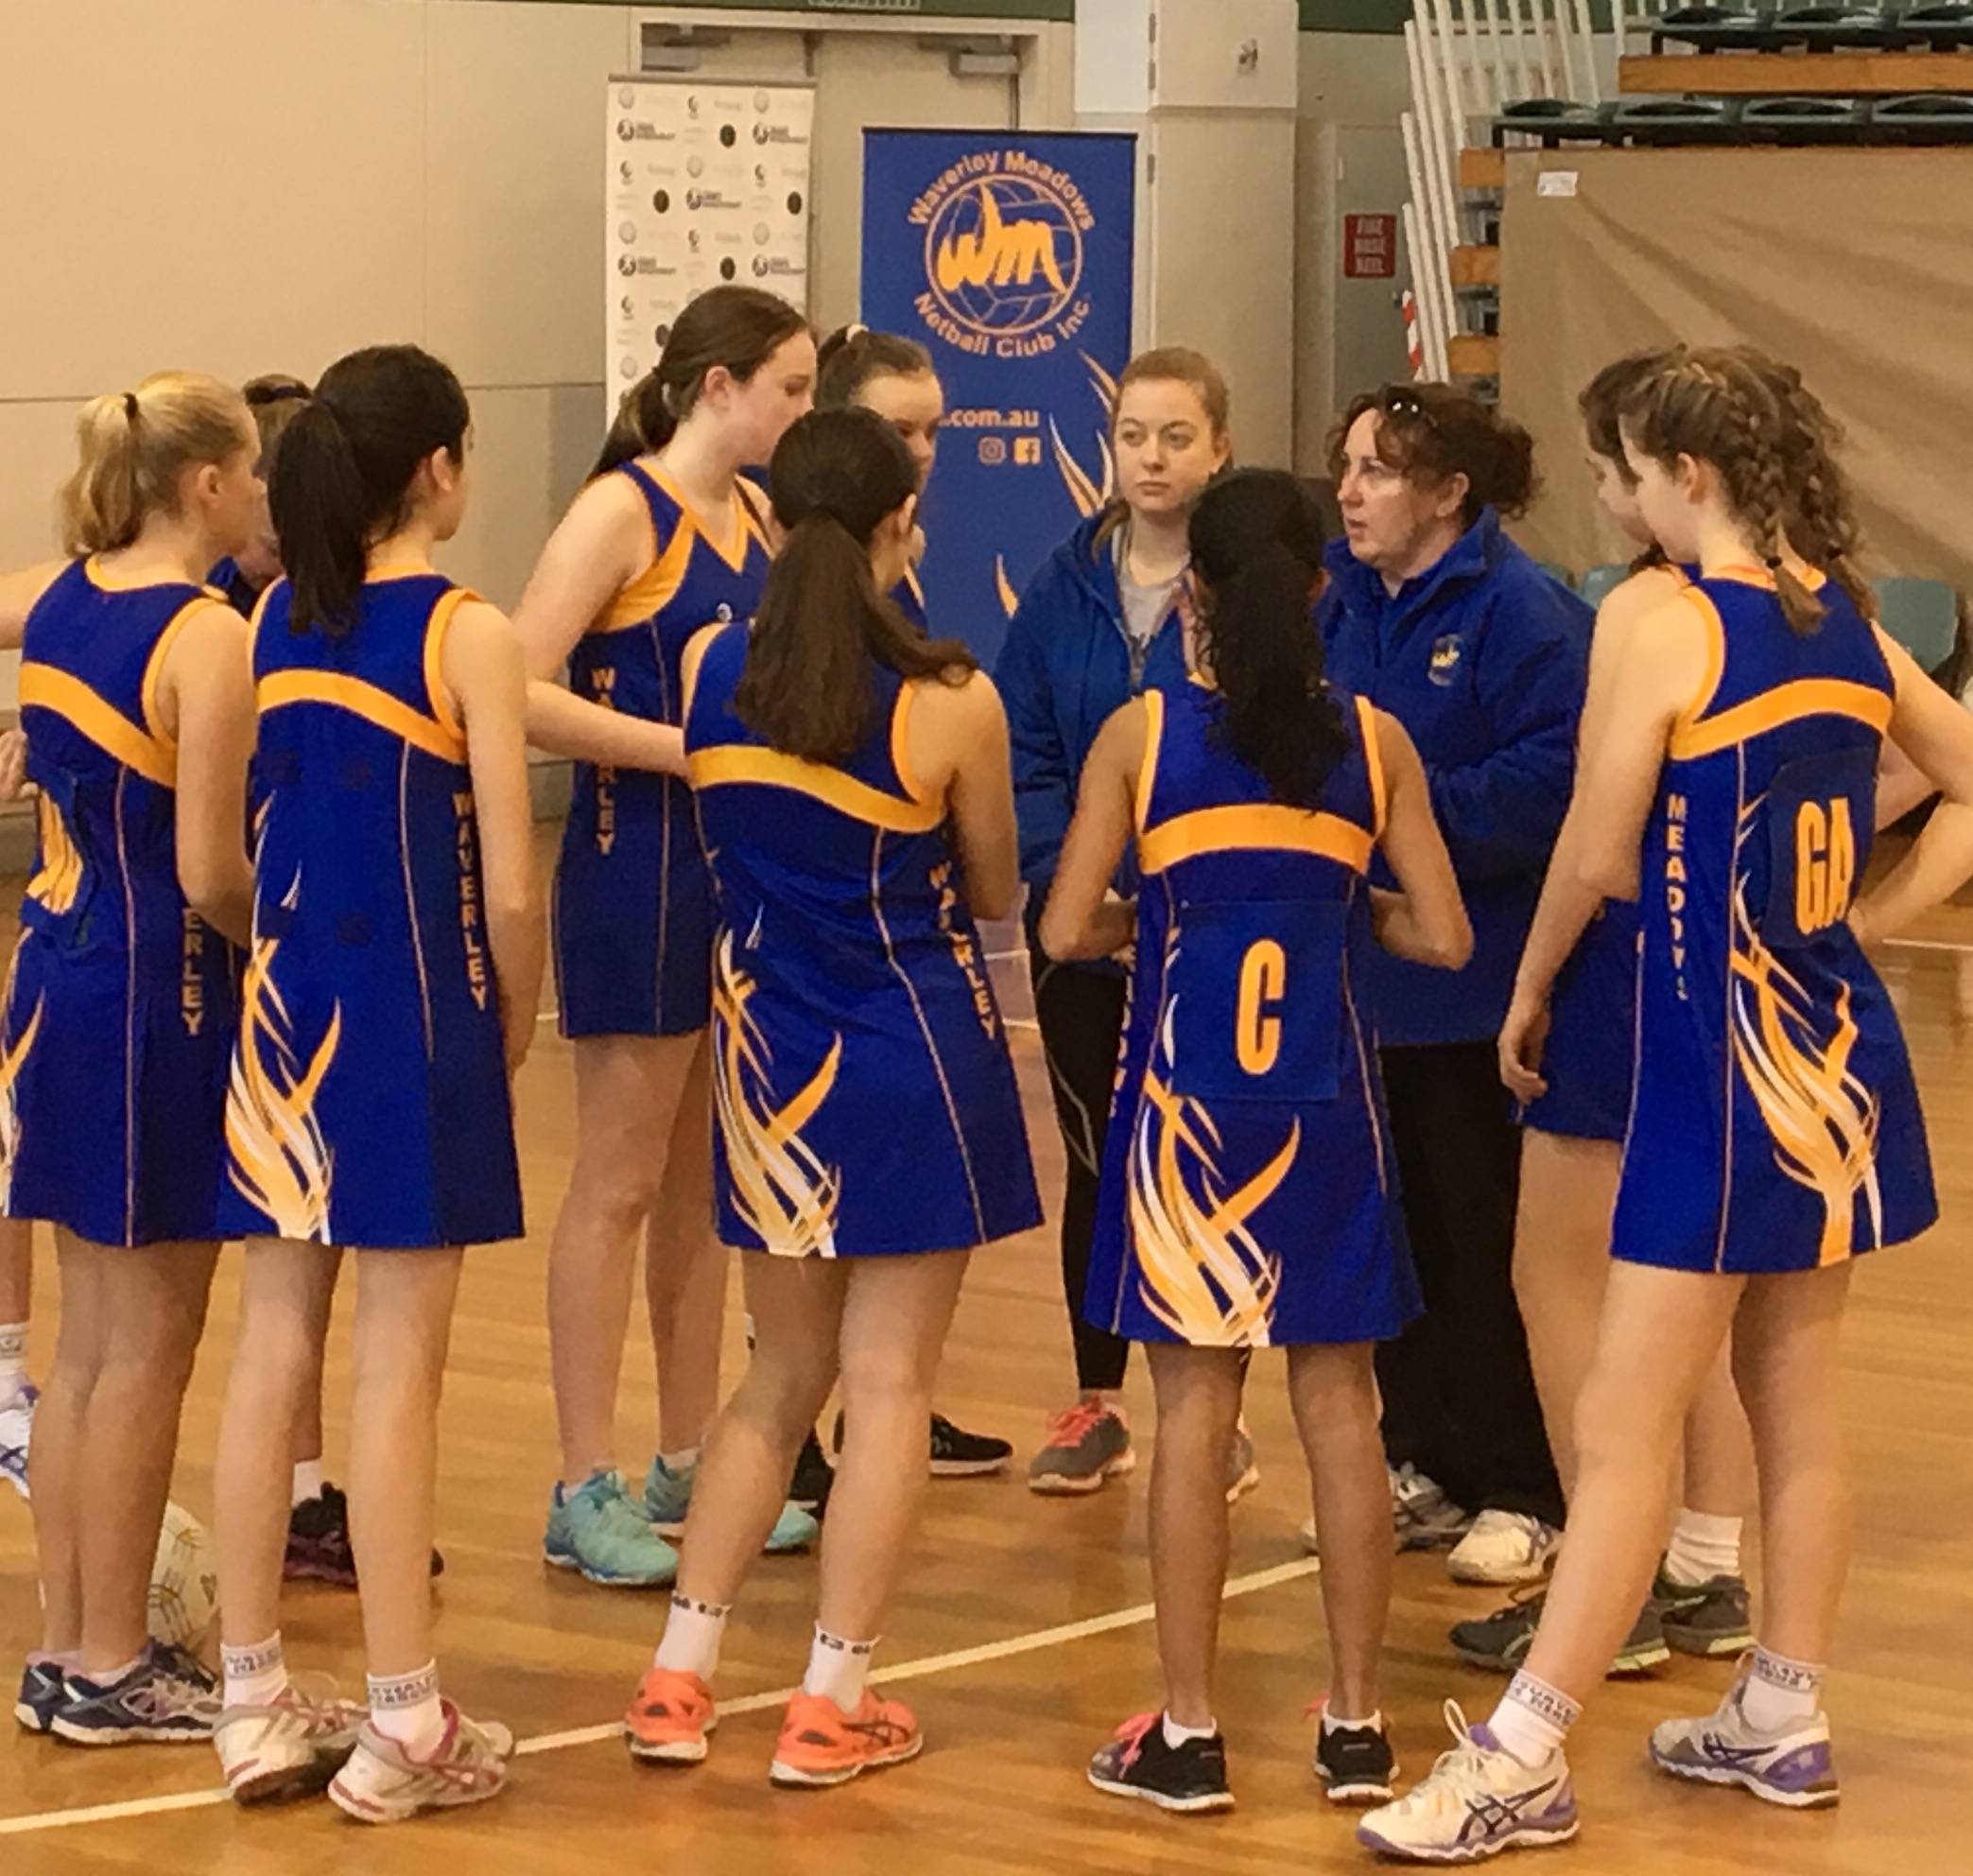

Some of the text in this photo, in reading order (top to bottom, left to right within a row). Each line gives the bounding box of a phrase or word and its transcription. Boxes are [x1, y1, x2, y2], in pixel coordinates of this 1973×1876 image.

[908, 149, 1096, 231] Waverley Meadows
[913, 293, 991, 356] Netball
[995, 332, 1057, 357] Club
[938, 409, 1039, 427] .com.au
[591, 668, 616, 855] WARLEY
[1797, 796, 1855, 935] GA
[1236, 938, 1286, 1075] C
